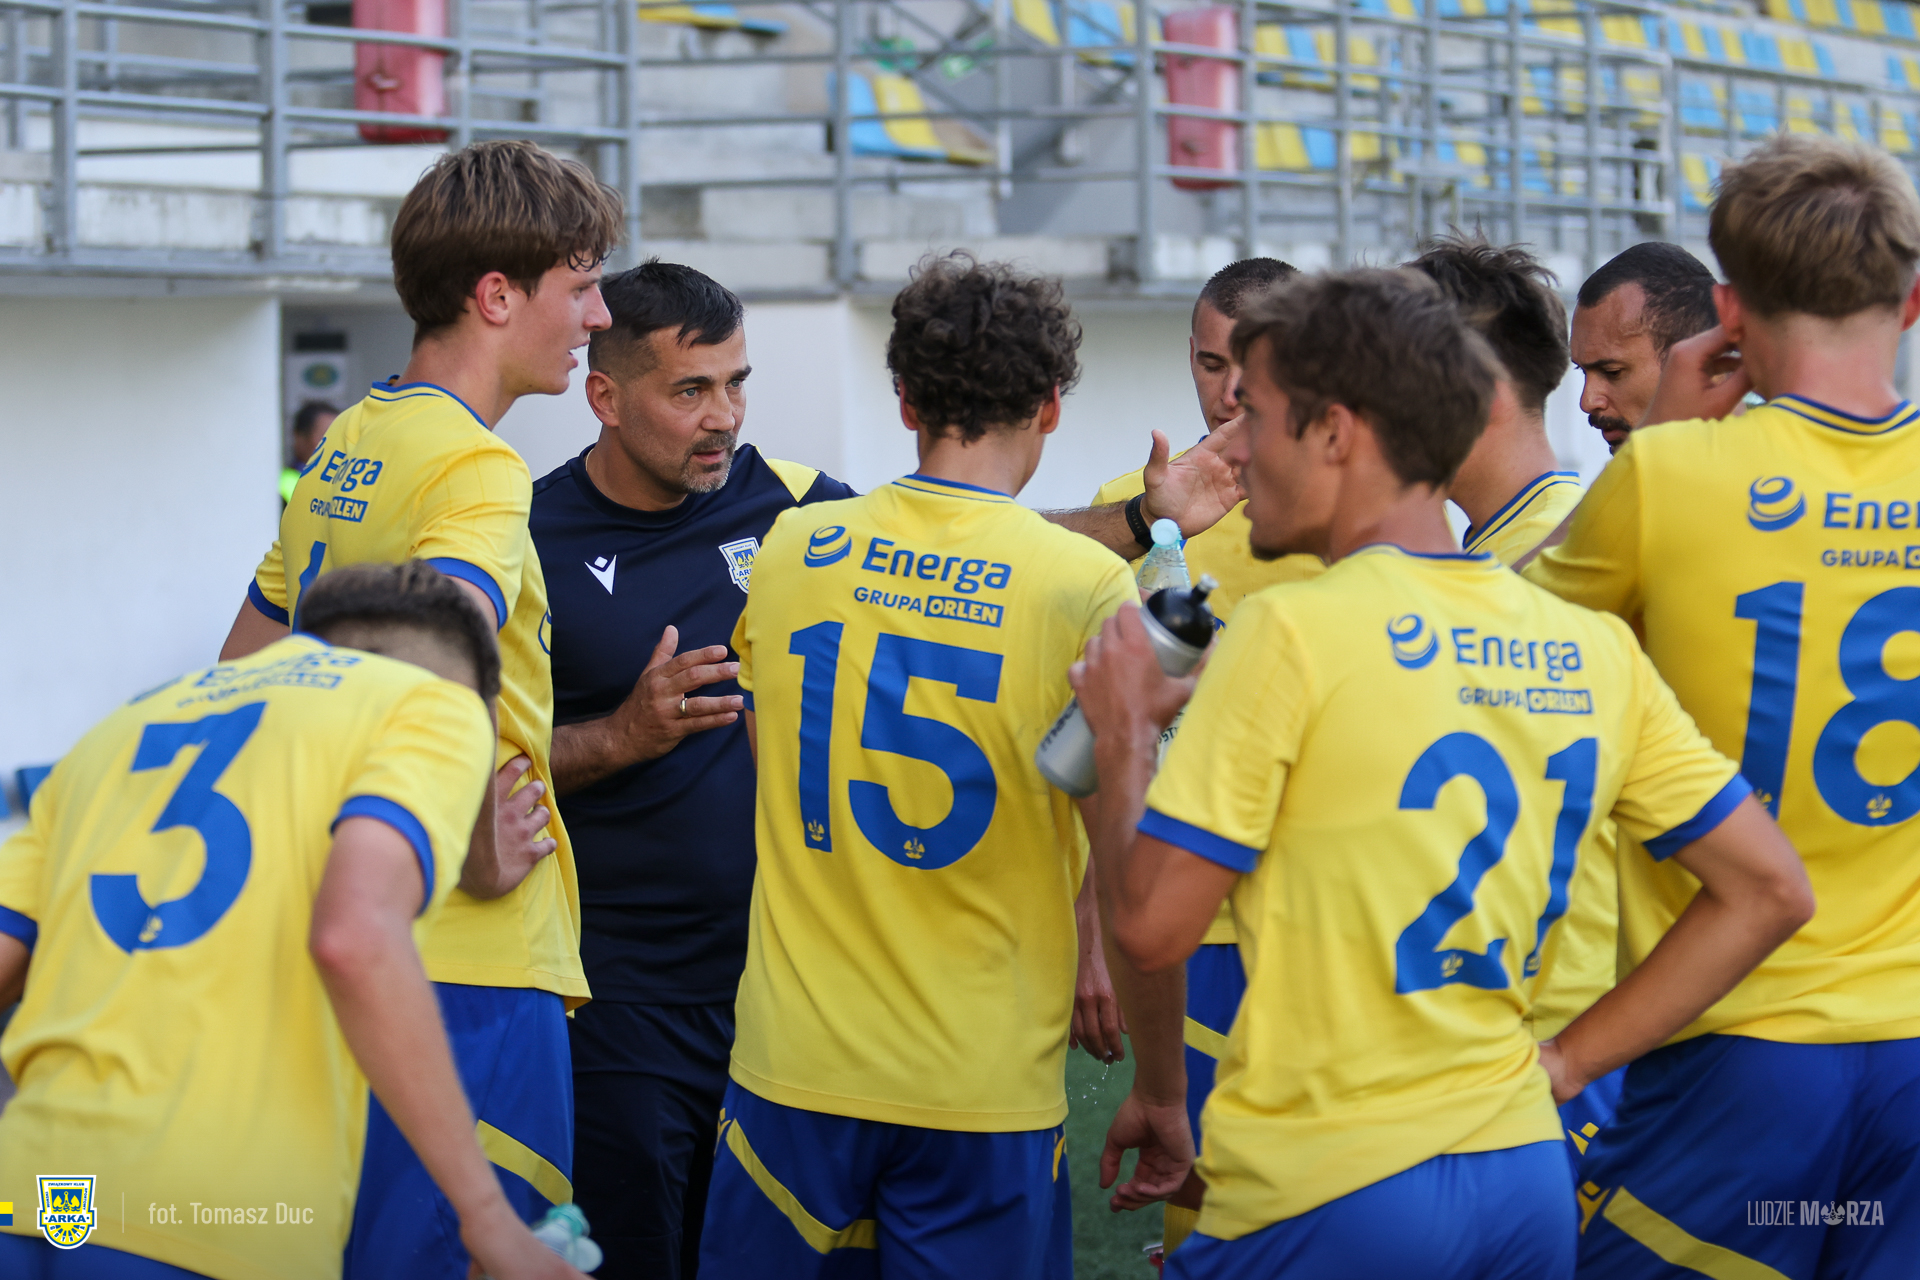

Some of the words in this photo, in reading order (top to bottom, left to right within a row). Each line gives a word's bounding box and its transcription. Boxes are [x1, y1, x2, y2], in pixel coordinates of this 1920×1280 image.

[861, 537, 1012, 594] Energa
[1821, 549, 1899, 567] GRUPA
[854, 587, 922, 613] GRUPA
[925, 596, 1003, 627] ORLEN
[1451, 628, 1583, 682] Energa
[1459, 687, 1527, 708] GRUPA
[1734, 580, 1920, 827] 18
[788, 620, 1004, 871] 15
[89, 700, 268, 957] 3
[1394, 731, 1599, 994] 21
